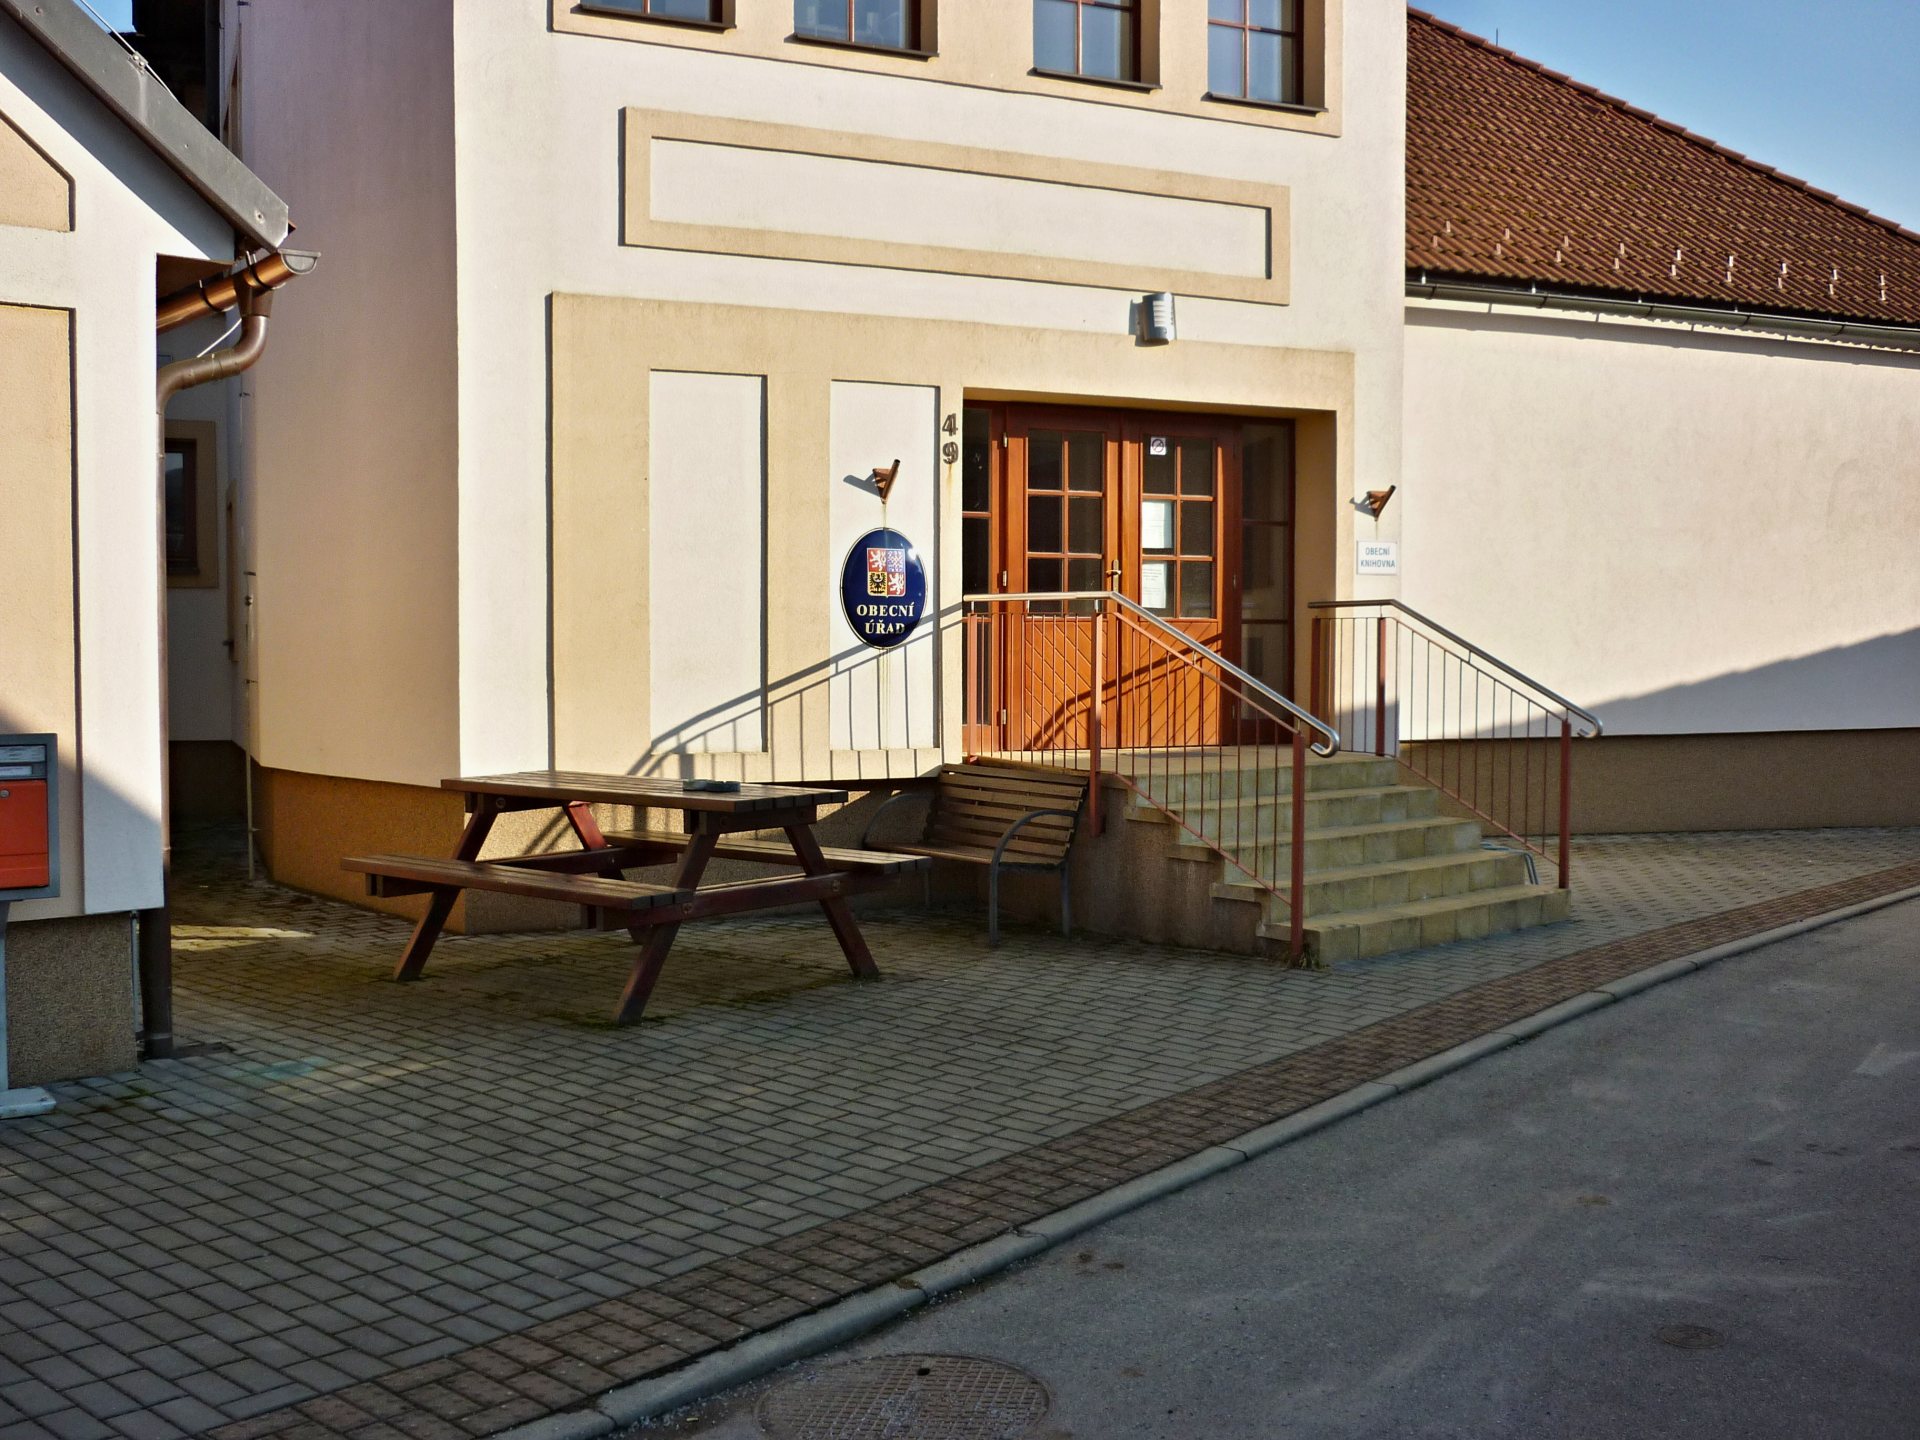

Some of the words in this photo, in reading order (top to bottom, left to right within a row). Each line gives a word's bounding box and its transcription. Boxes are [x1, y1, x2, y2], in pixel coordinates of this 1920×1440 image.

[1360, 559, 1396, 568] KNIHOVNA
[856, 602, 915, 617] OBECNÍ
[865, 619, 905, 634] ÚŘAD
